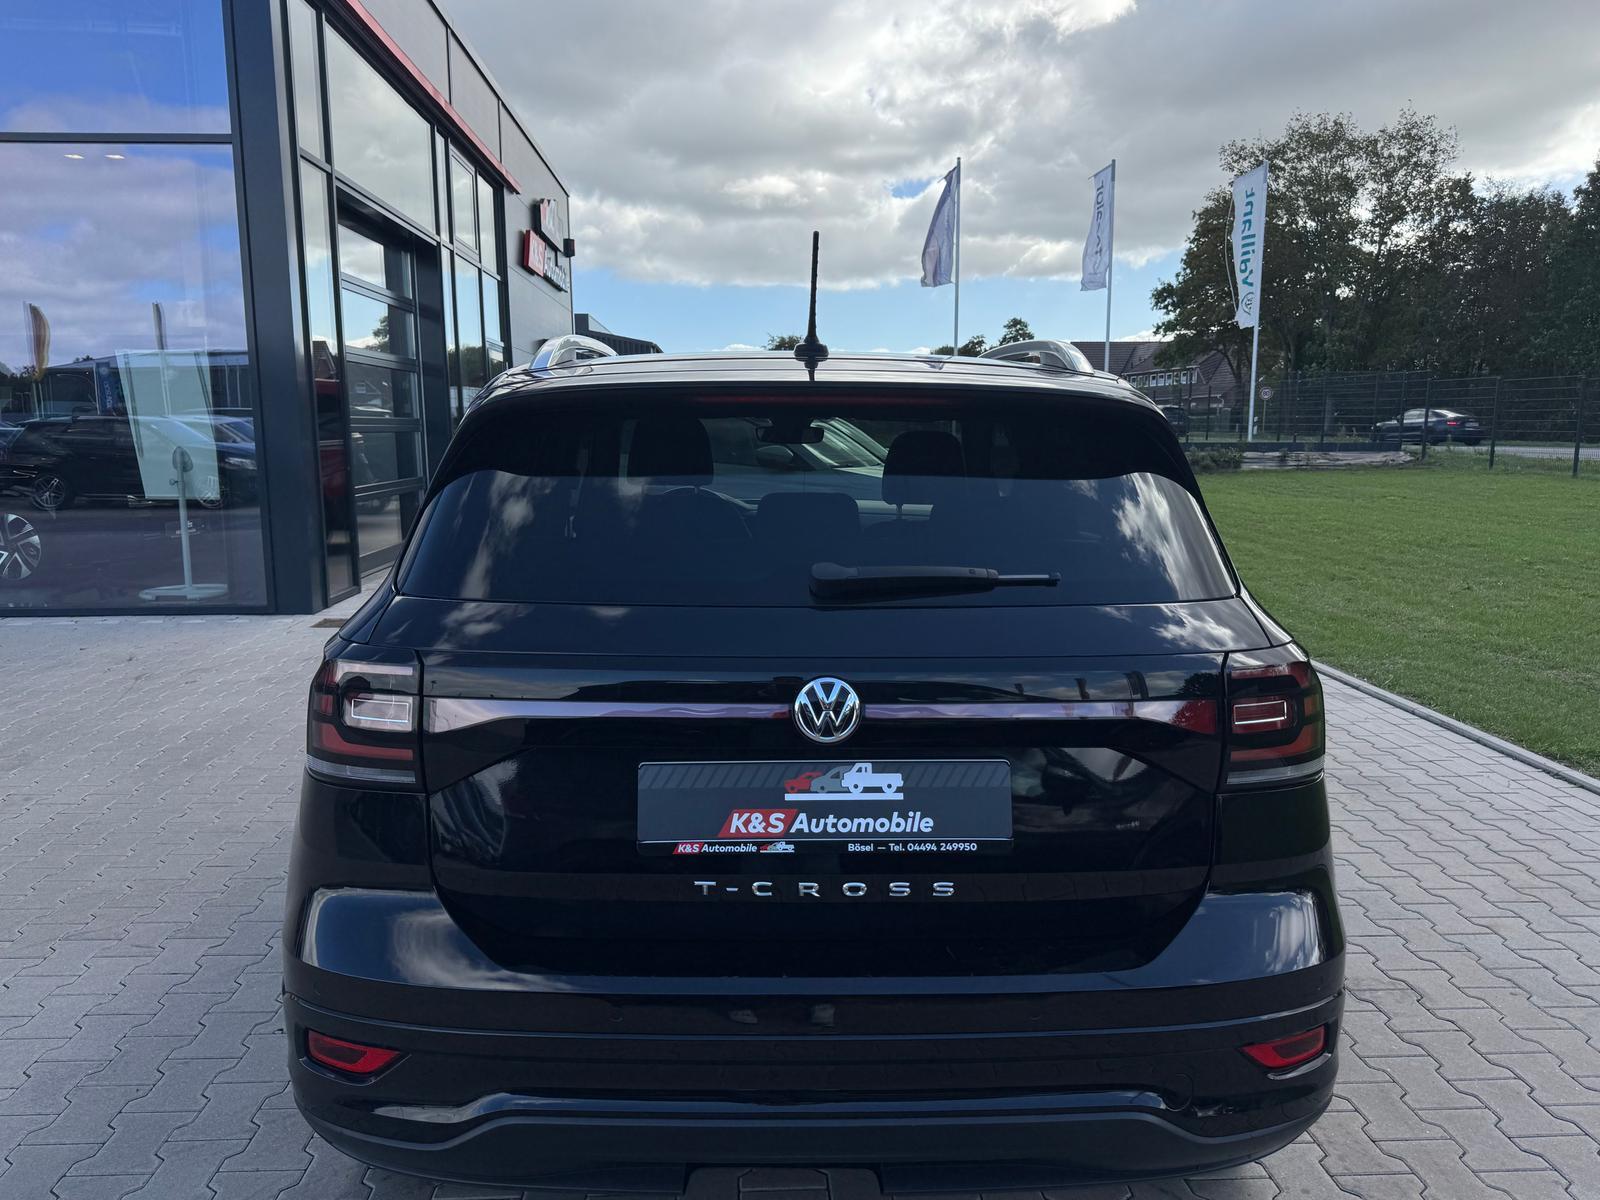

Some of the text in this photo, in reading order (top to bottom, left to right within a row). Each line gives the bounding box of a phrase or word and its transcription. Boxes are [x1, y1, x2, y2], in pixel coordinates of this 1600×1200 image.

[729, 811, 934, 833] K&S Automobile
[677, 843, 758, 853] K&S Automobile
[848, 842, 874, 852] Bösel
[889, 843, 905, 852] Tel.
[907, 843, 937, 852] 04494
[940, 842, 977, 851] 249950
[694, 880, 955, 898] T-CROSS
